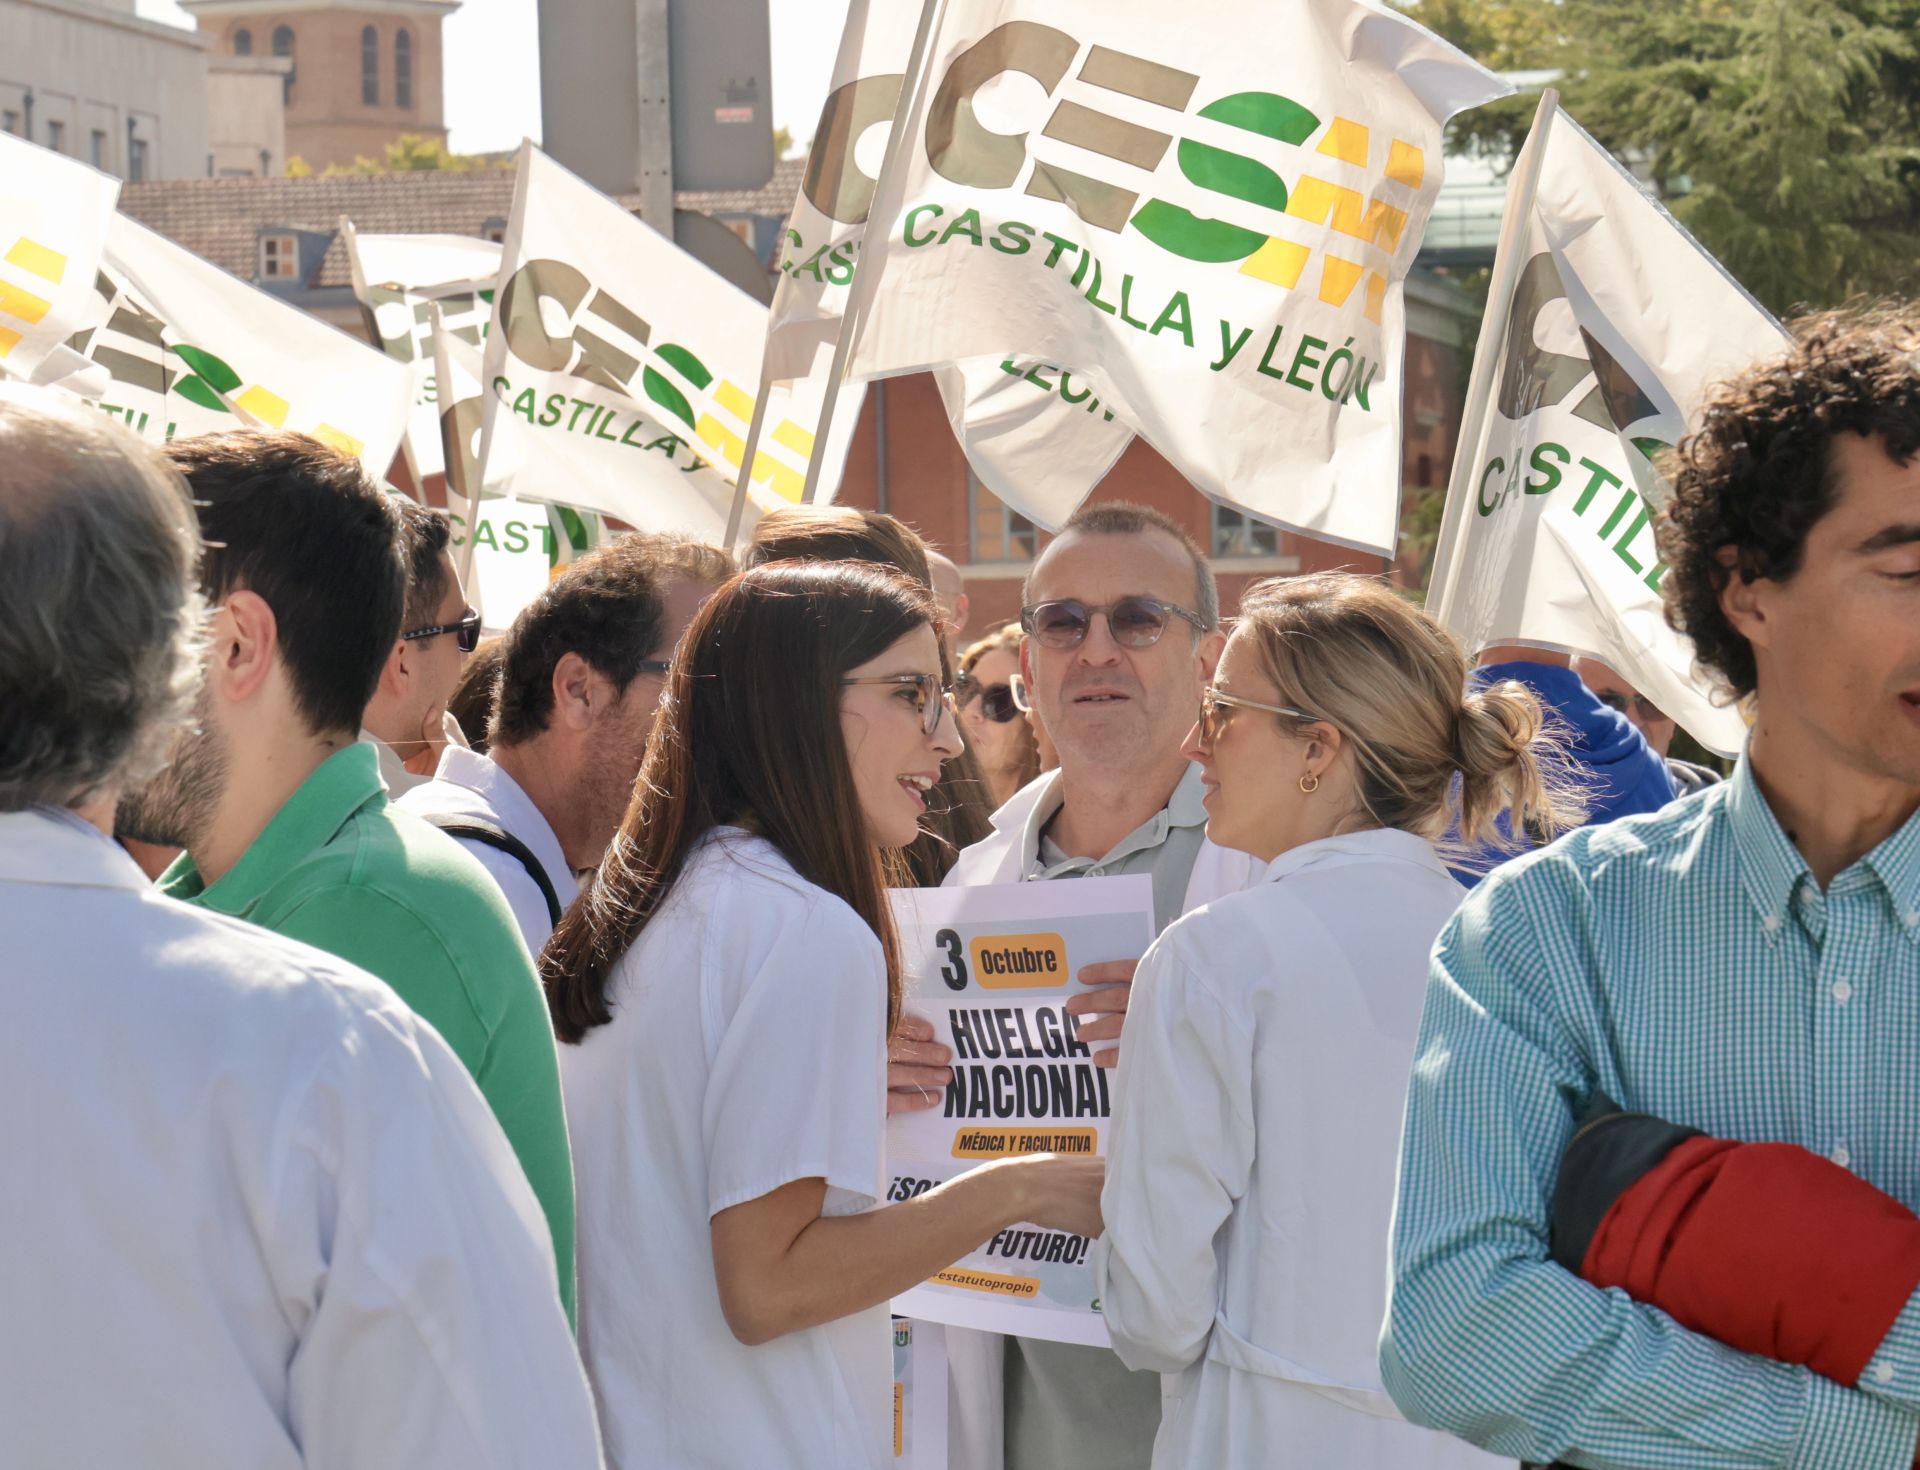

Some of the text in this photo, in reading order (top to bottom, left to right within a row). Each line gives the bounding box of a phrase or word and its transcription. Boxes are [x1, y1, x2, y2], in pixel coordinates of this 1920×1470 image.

[925, 21, 1424, 326] CESM
[783, 228, 862, 285] CAS
[903, 204, 1378, 413] CASTILLA y LEÓN
[493, 376, 690, 459] CASTILLA
[935, 928, 1058, 991] 3 Octubre
[948, 1006, 1091, 1060] HUELGA
[959, 1131, 1091, 1152] MÉDICA Y FACULTATIVA
[886, 1177, 942, 1201] ¡SO
[986, 1230, 1091, 1265] FUTURO!
